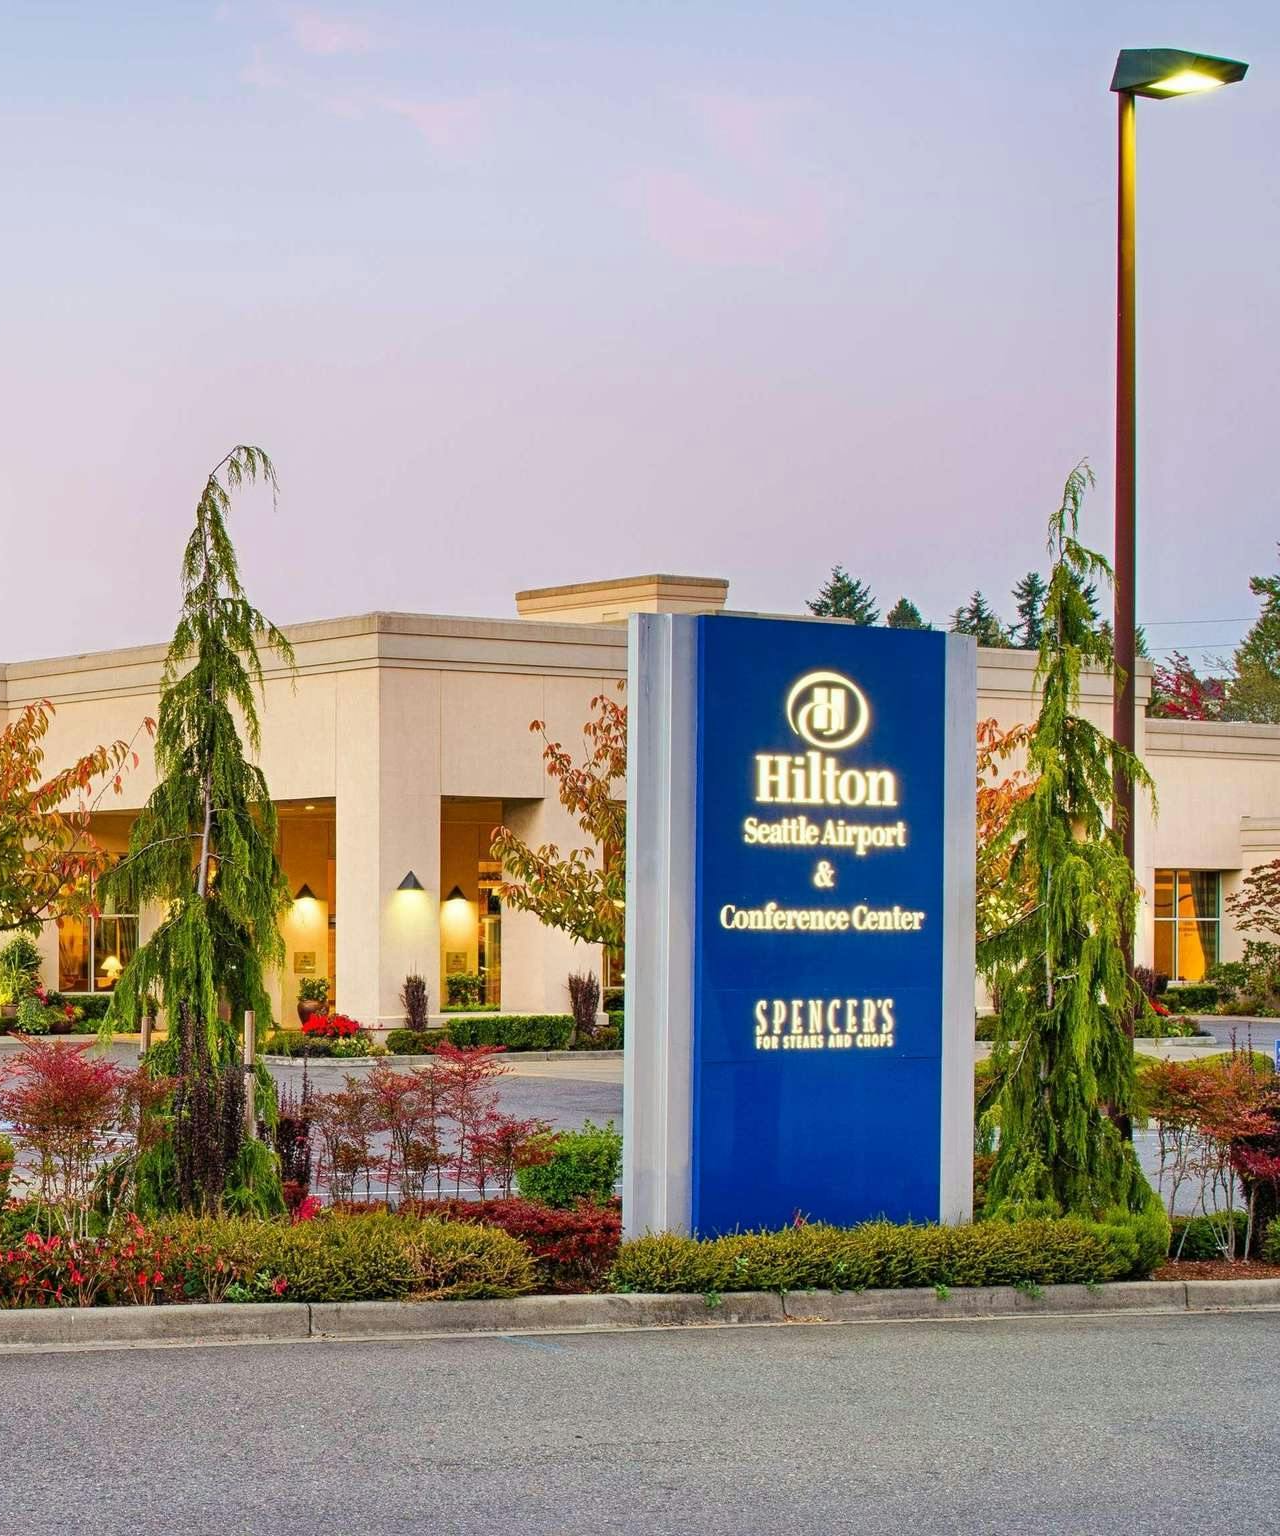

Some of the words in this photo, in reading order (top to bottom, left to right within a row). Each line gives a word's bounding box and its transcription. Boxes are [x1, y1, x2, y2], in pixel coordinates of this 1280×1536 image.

[755, 751, 898, 807] Hilton
[743, 815, 819, 845] Seattle
[820, 819, 907, 856] Airport
[813, 860, 835, 888] &
[720, 902, 850, 931] Conference
[852, 904, 926, 931] Center
[755, 998, 895, 1036] SPENCER'S
[755, 1035, 780, 1050] FOR
[782, 1034, 825, 1050] STEAKS
[827, 1034, 853, 1049] AND
[856, 1033, 894, 1048] CHOPS
